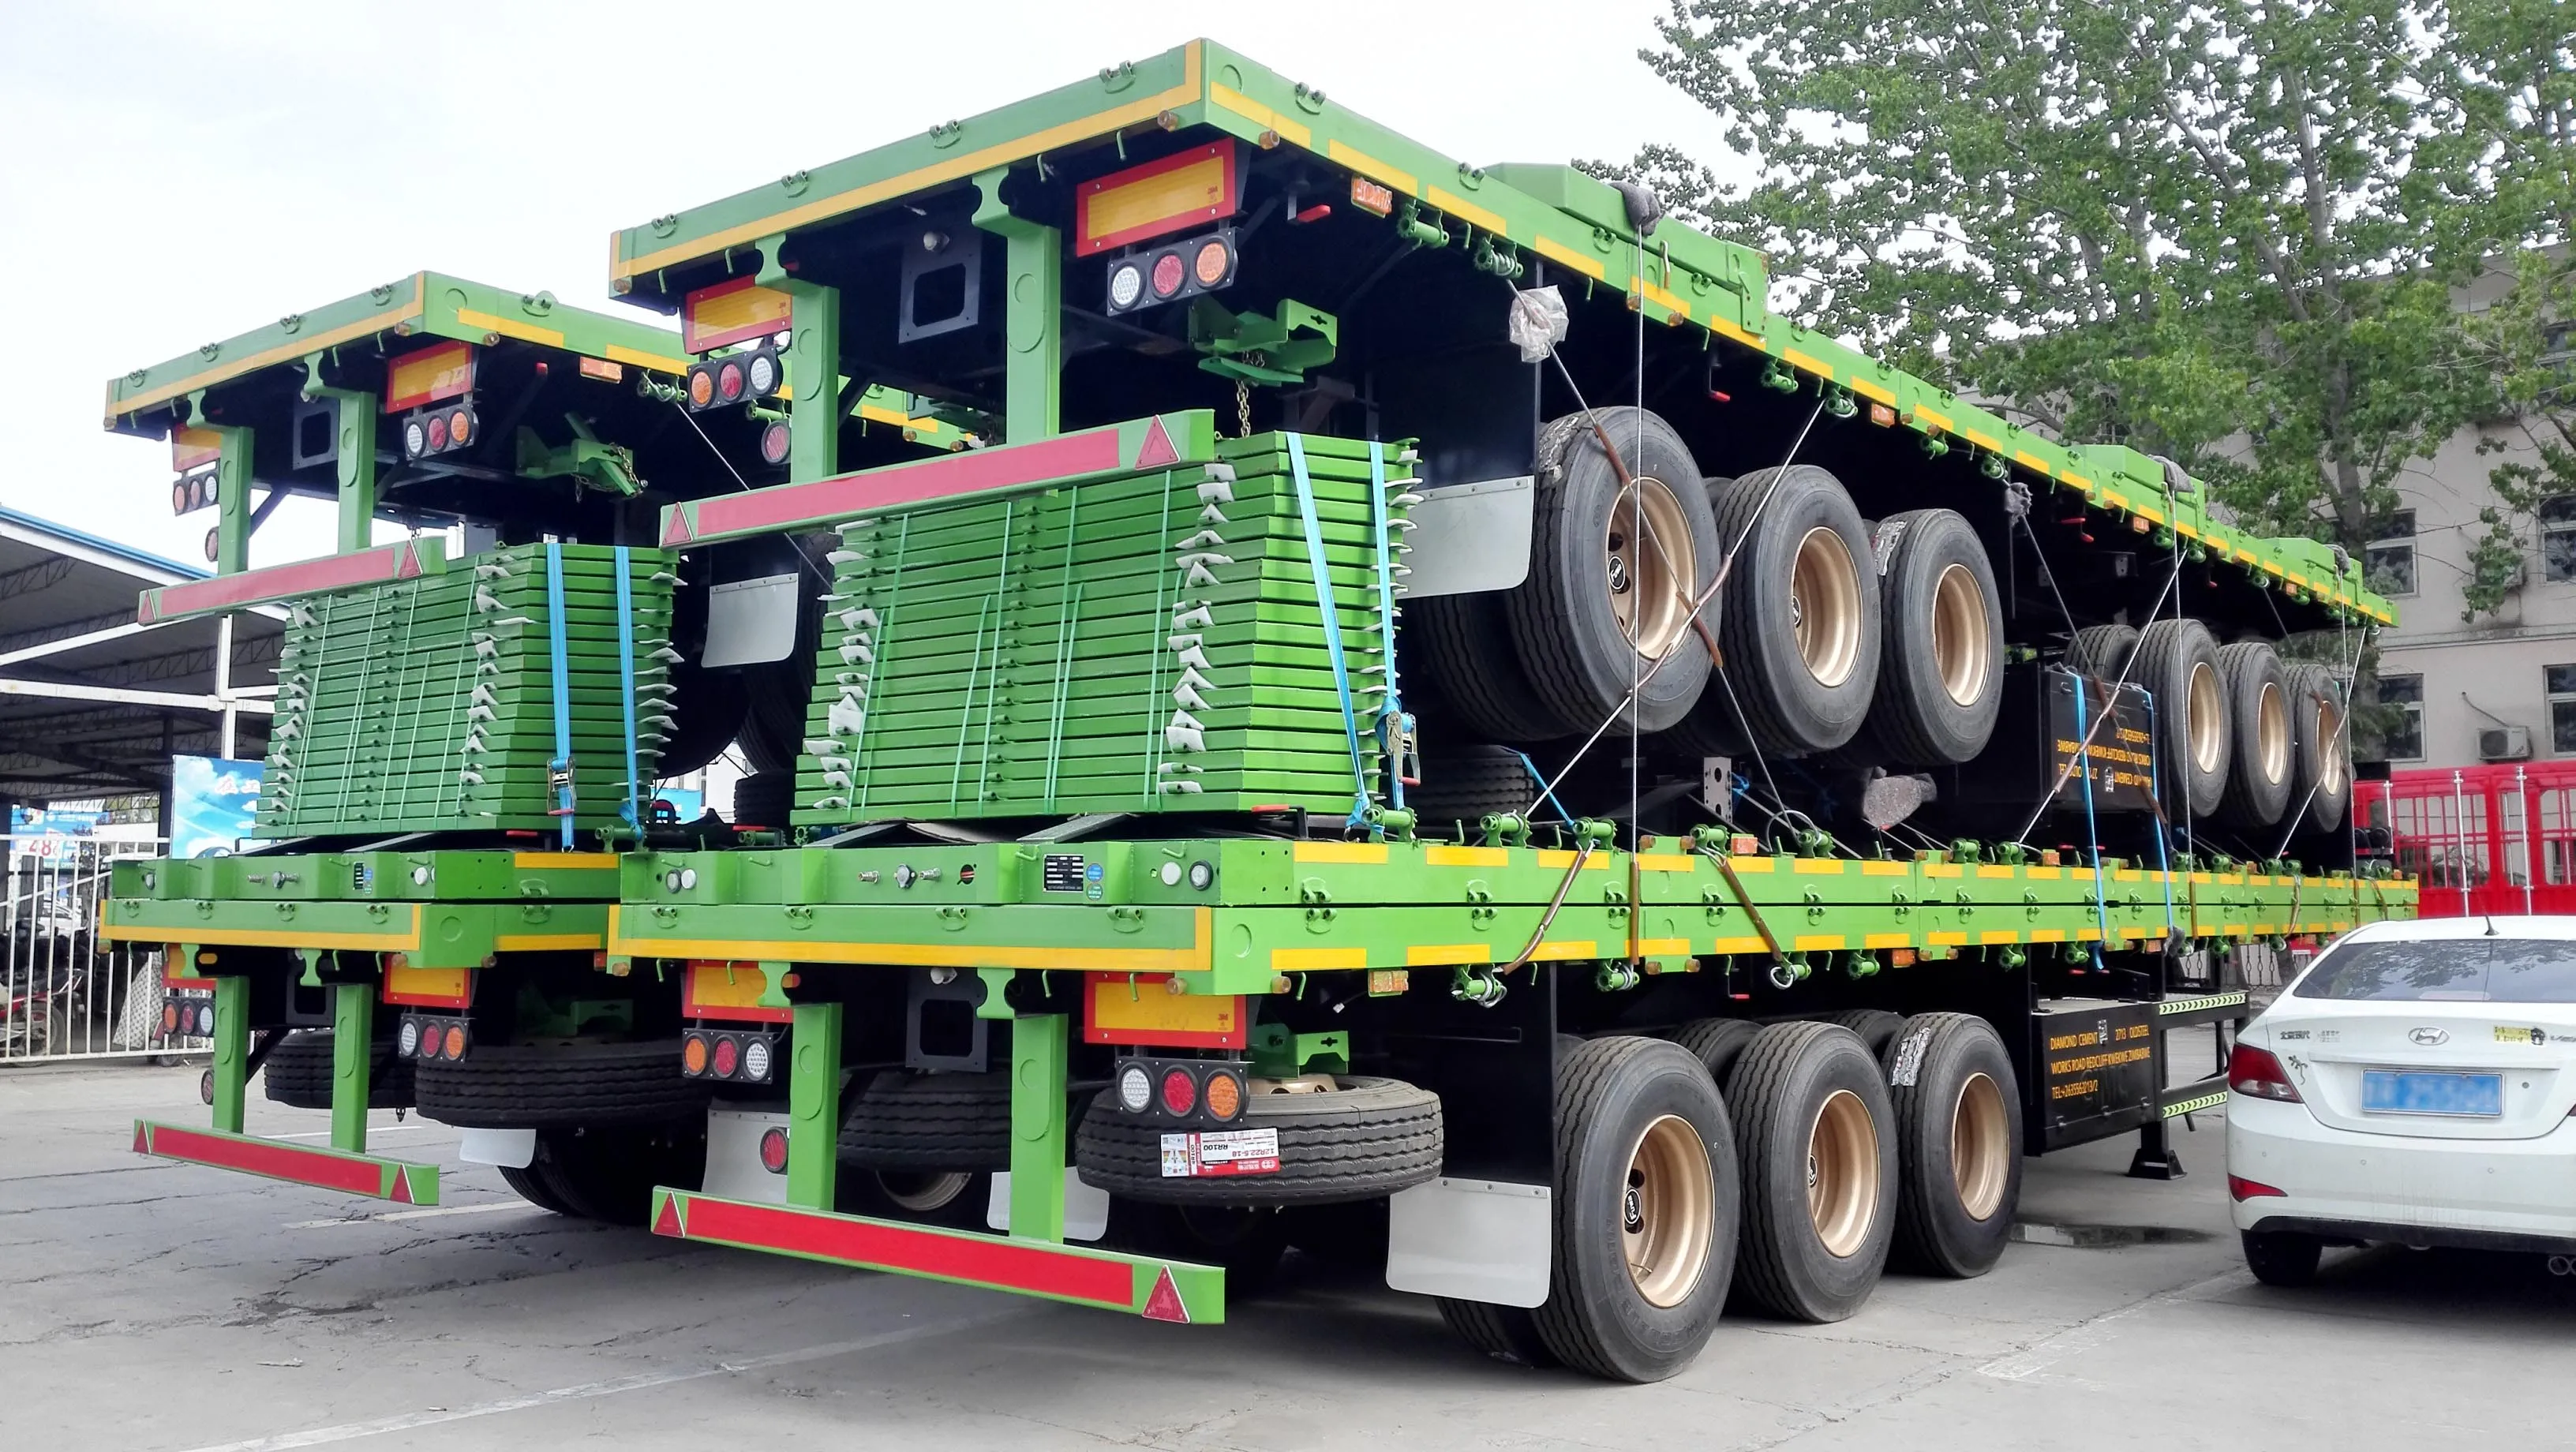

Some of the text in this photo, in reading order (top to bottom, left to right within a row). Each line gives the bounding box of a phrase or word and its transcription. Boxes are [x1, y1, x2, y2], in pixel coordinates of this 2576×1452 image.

[2089, 767, 2098, 780] 271
[2050, 1035, 2077, 1050] DIAMOND
[2079, 1031, 2098, 1046] CEMENT
[2051, 1060, 2072, 1074] WORKS
[2072, 1057, 2086, 1072] ROAD
